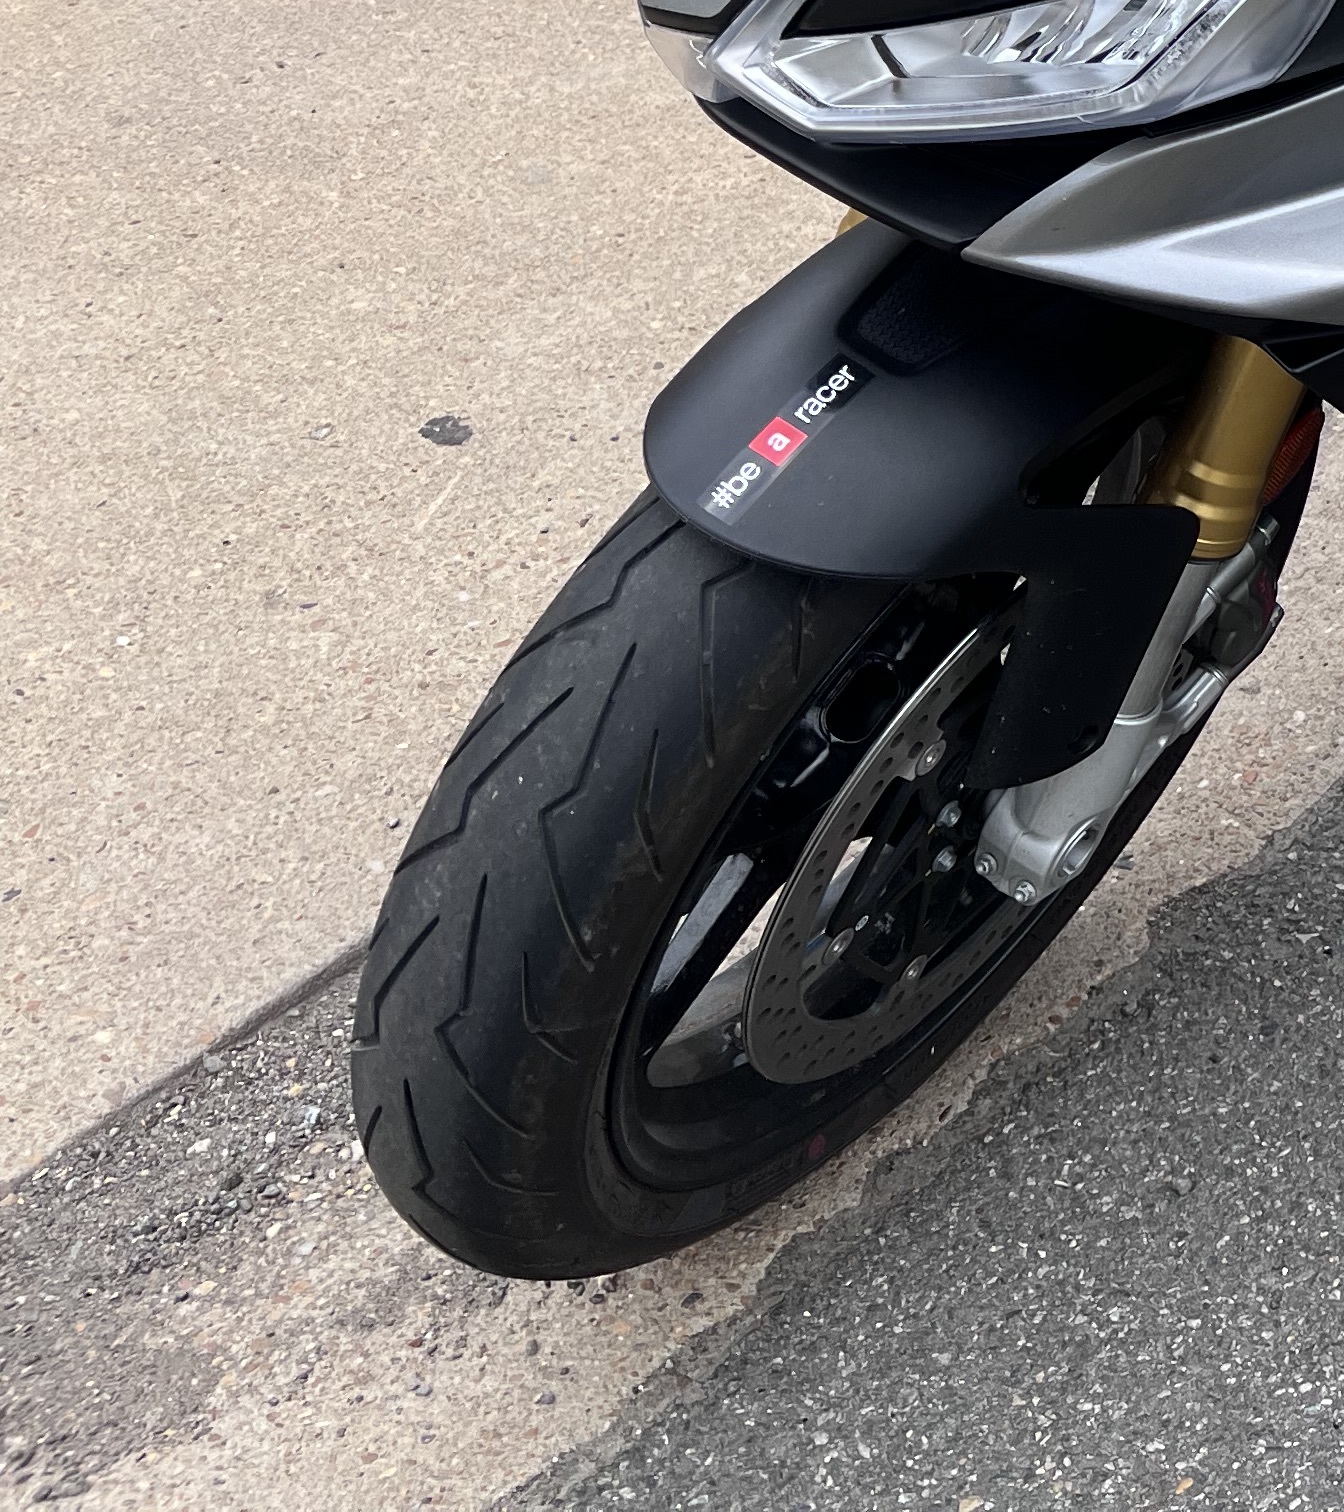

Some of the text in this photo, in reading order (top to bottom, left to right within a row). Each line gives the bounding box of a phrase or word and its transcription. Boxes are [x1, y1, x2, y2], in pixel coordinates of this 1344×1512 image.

[711, 365, 855, 509] #be a racer
